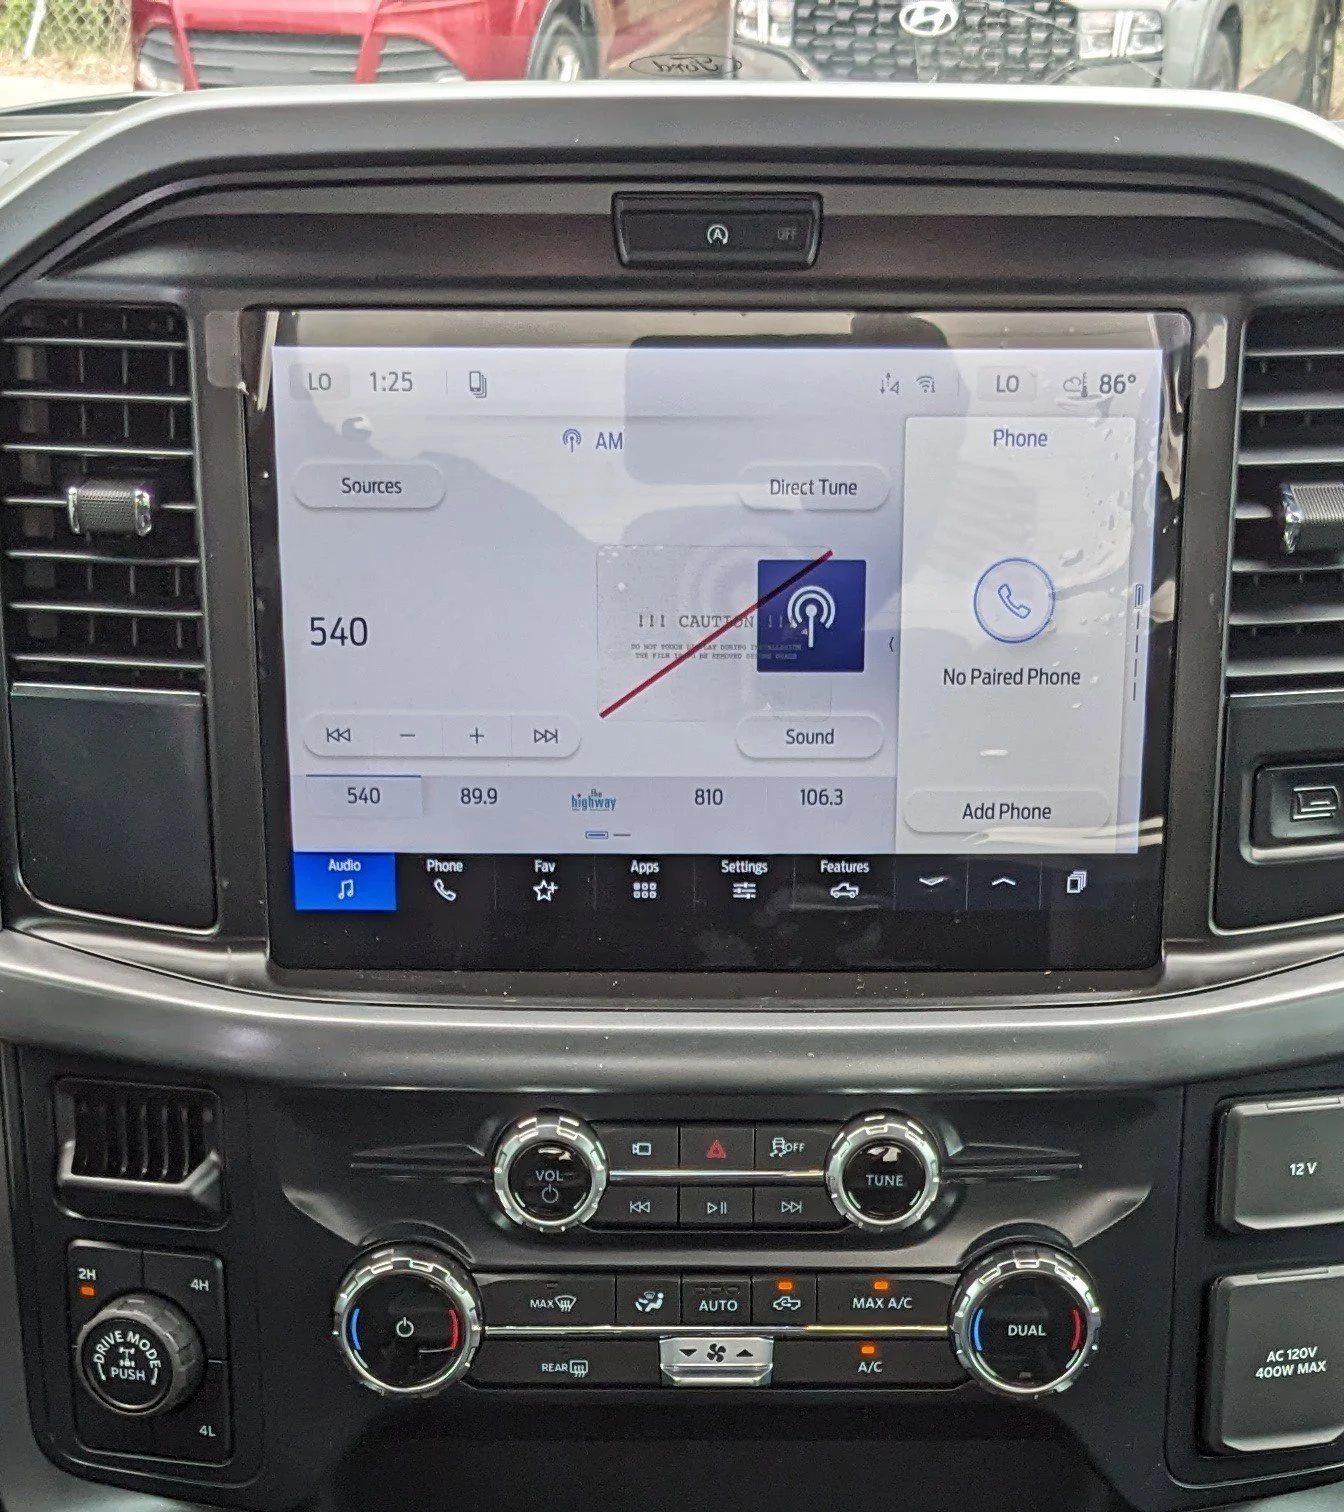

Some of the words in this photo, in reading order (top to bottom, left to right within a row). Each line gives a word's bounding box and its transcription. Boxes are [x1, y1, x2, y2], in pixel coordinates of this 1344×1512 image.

[777, 226, 797, 241] OFF
[308, 372, 332, 392] LO
[369, 371, 414, 393] 1:25
[996, 374, 1020, 393] LO
[1099, 374, 1137, 395] 86°
[595, 431, 624, 451] AM
[992, 428, 1048, 449] Phone
[341, 477, 403, 496] Sources
[769, 478, 815, 497] Direct
[819, 478, 858, 497] Tune
[309, 616, 369, 647] 540
[943, 669, 967, 686] No
[971, 668, 1024, 686] Paired
[1027, 668, 1081, 686] Phone
[785, 728, 835, 746] Sound
[347, 788, 381, 805] 540
[460, 788, 498, 805] 89.9
[571, 794, 617, 812] highway
[694, 788, 724, 806] 810
[800, 788, 844, 806] 106.3
[962, 803, 995, 820] Add
[999, 803, 1052, 820] Phone
[328, 859, 362, 873] Audio
[426, 859, 463, 874] Phone
[534, 860, 556, 873] Fav
[630, 860, 659, 877] Apps
[721, 859, 768, 877] Settings
[820, 860, 869, 874] Features
[785, 1142, 805, 1153] OFF
[535, 1170, 564, 1183] VOL
[1289, 1163, 1305, 1176] 12
[1306, 1162, 1317, 1175] V
[866, 1174, 904, 1187] TUNE
[77, 1268, 97, 1281] 2H
[190, 1278, 210, 1292] 4H
[529, 1298, 555, 1309] MAX
[698, 1299, 738, 1312] AUTO
[852, 1297, 884, 1309] MAX
[887, 1296, 913, 1310] A/C
[1007, 1324, 1046, 1338] DUAL
[93, 1330, 123, 1365] DRIVE
[126, 1330, 161, 1369] MODE
[1266, 1349, 1285, 1363] AC
[1287, 1346, 1318, 1361] 120V
[111, 1366, 146, 1381] PUSH
[541, 1363, 569, 1374] REAR
[857, 1360, 883, 1374] A/C
[1255, 1364, 1294, 1379] 400W
[1297, 1360, 1327, 1375] MAX
[199, 1425, 216, 1437] 4L
